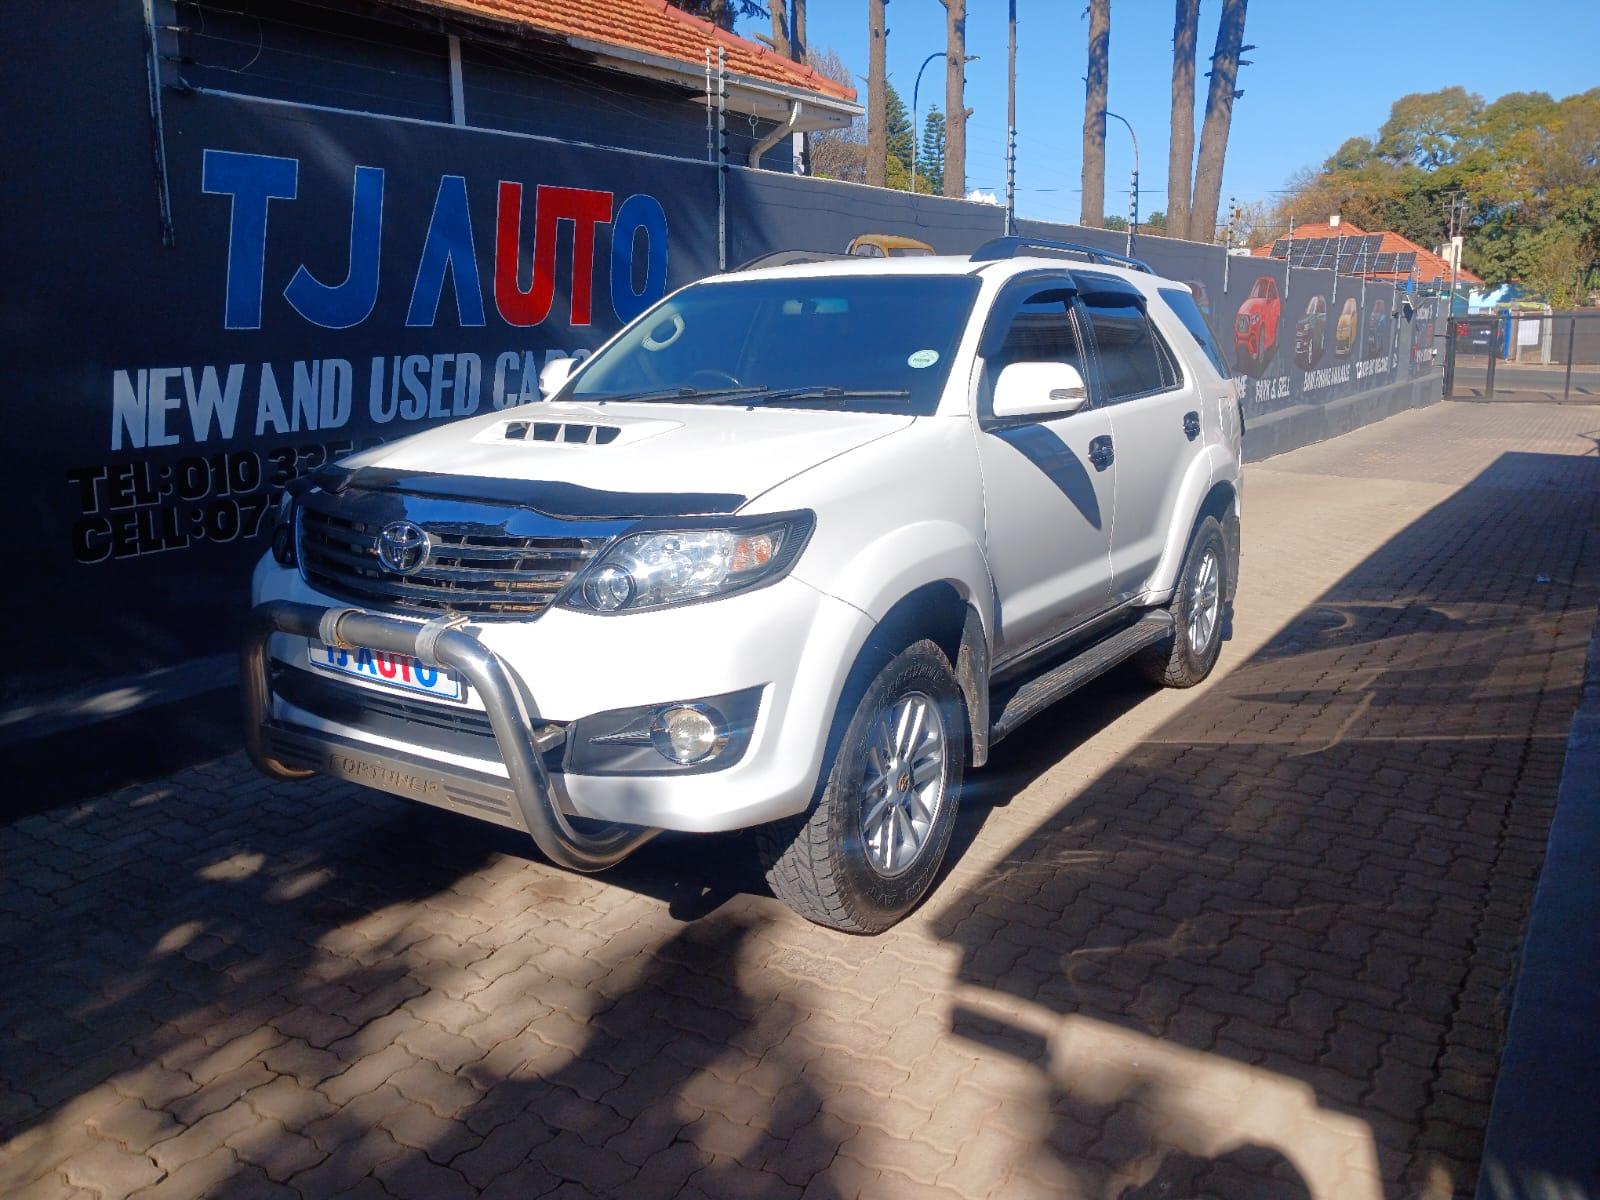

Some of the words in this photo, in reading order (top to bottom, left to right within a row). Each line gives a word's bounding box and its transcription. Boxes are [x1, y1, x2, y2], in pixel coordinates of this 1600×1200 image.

[202, 149, 385, 329] TJ
[405, 174, 669, 327] AUTO
[111, 363, 245, 451] NEW
[255, 358, 352, 436] AND
[369, 352, 482, 423] USED
[493, 348, 593, 410] CA
[71, 494, 280, 564] CELL:07
